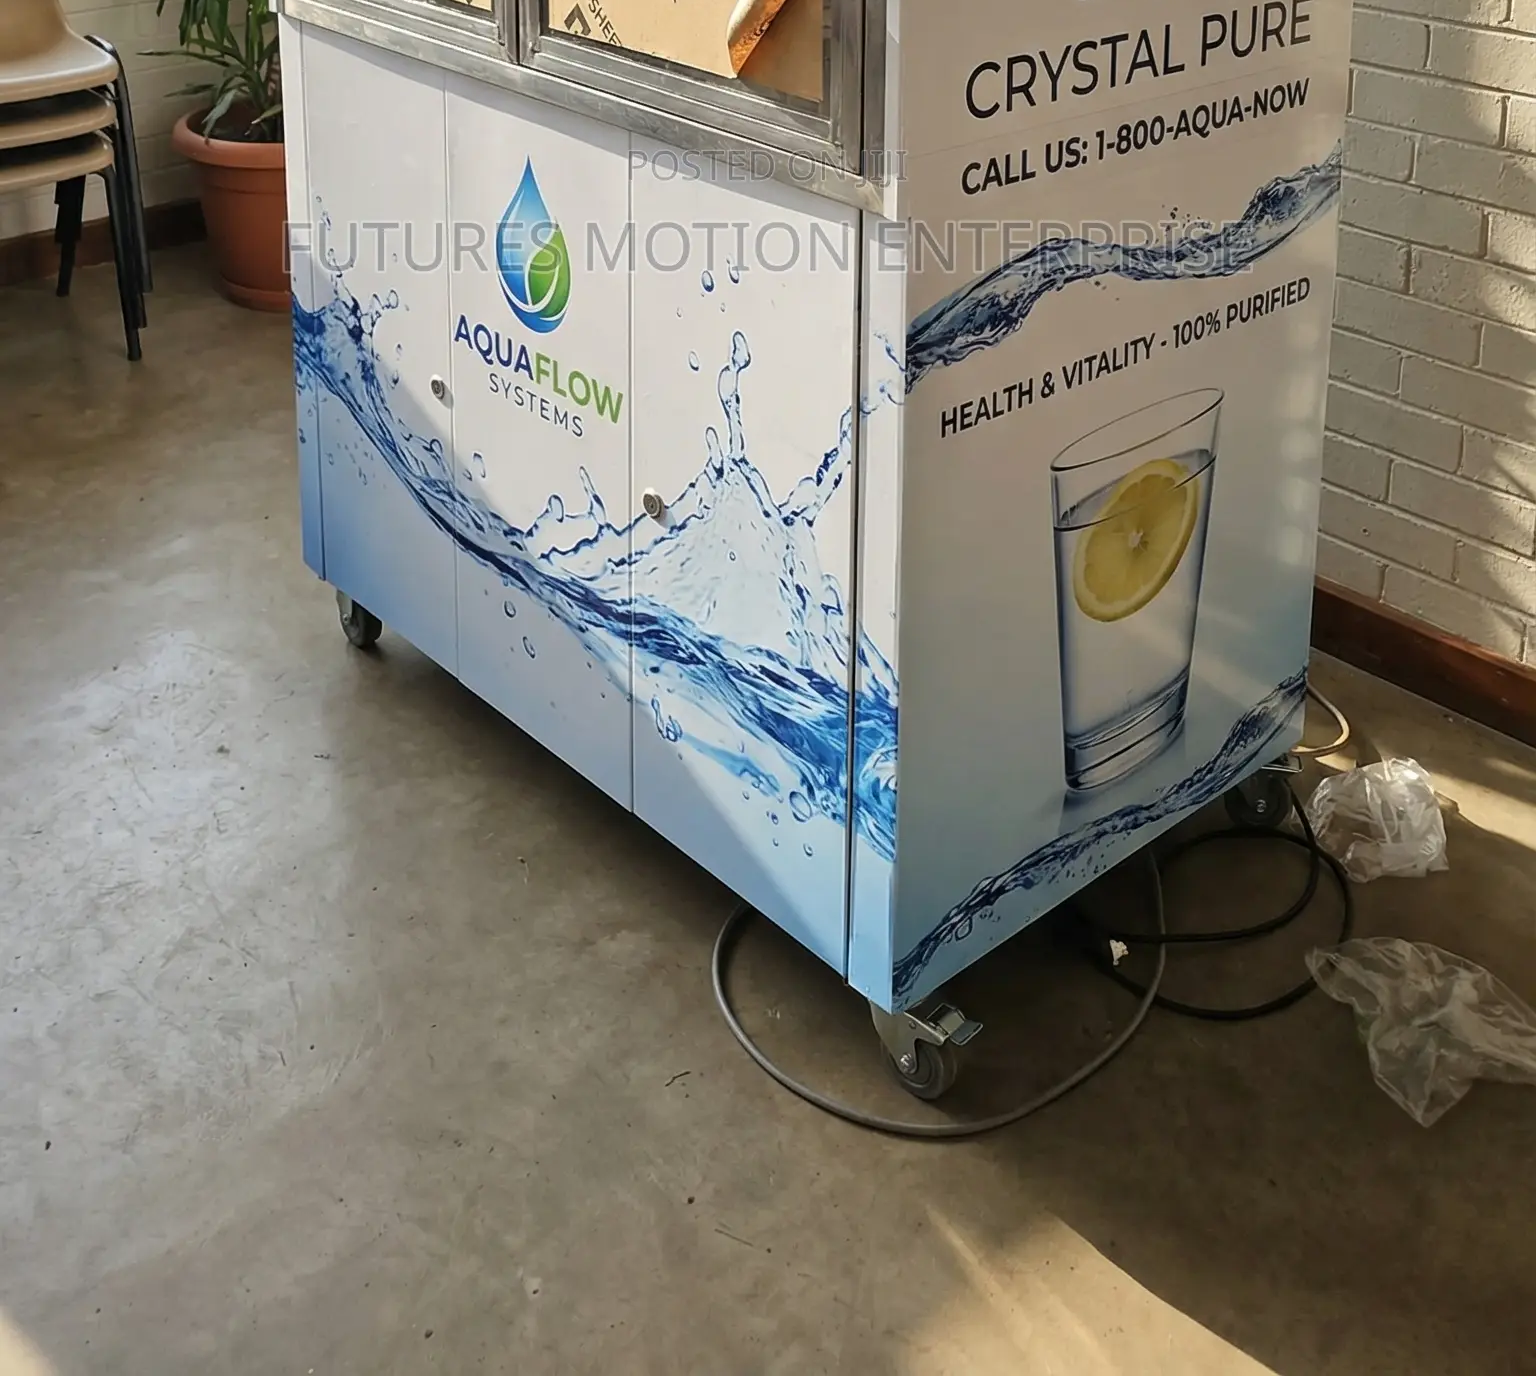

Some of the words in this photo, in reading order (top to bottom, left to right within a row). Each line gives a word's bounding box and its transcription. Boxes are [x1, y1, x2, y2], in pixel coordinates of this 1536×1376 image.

[965, 24, 1186, 119] CRYSTAL
[961, 149, 1036, 195] CALL
[1045, 136, 1088, 173] US:
[1096, 78, 1310, 161] 1-800-AQUA-NOW
[453, 313, 625, 424] AQUAFLOW
[488, 372, 584, 438] SYSTEMS
[941, 377, 1034, 438] HEALTH
[1040, 371, 1056, 399] &
[1062, 333, 1157, 390] VITALITY
[1173, 309, 1221, 350] 100%
[1225, 277, 1311, 331] PURIFIED
